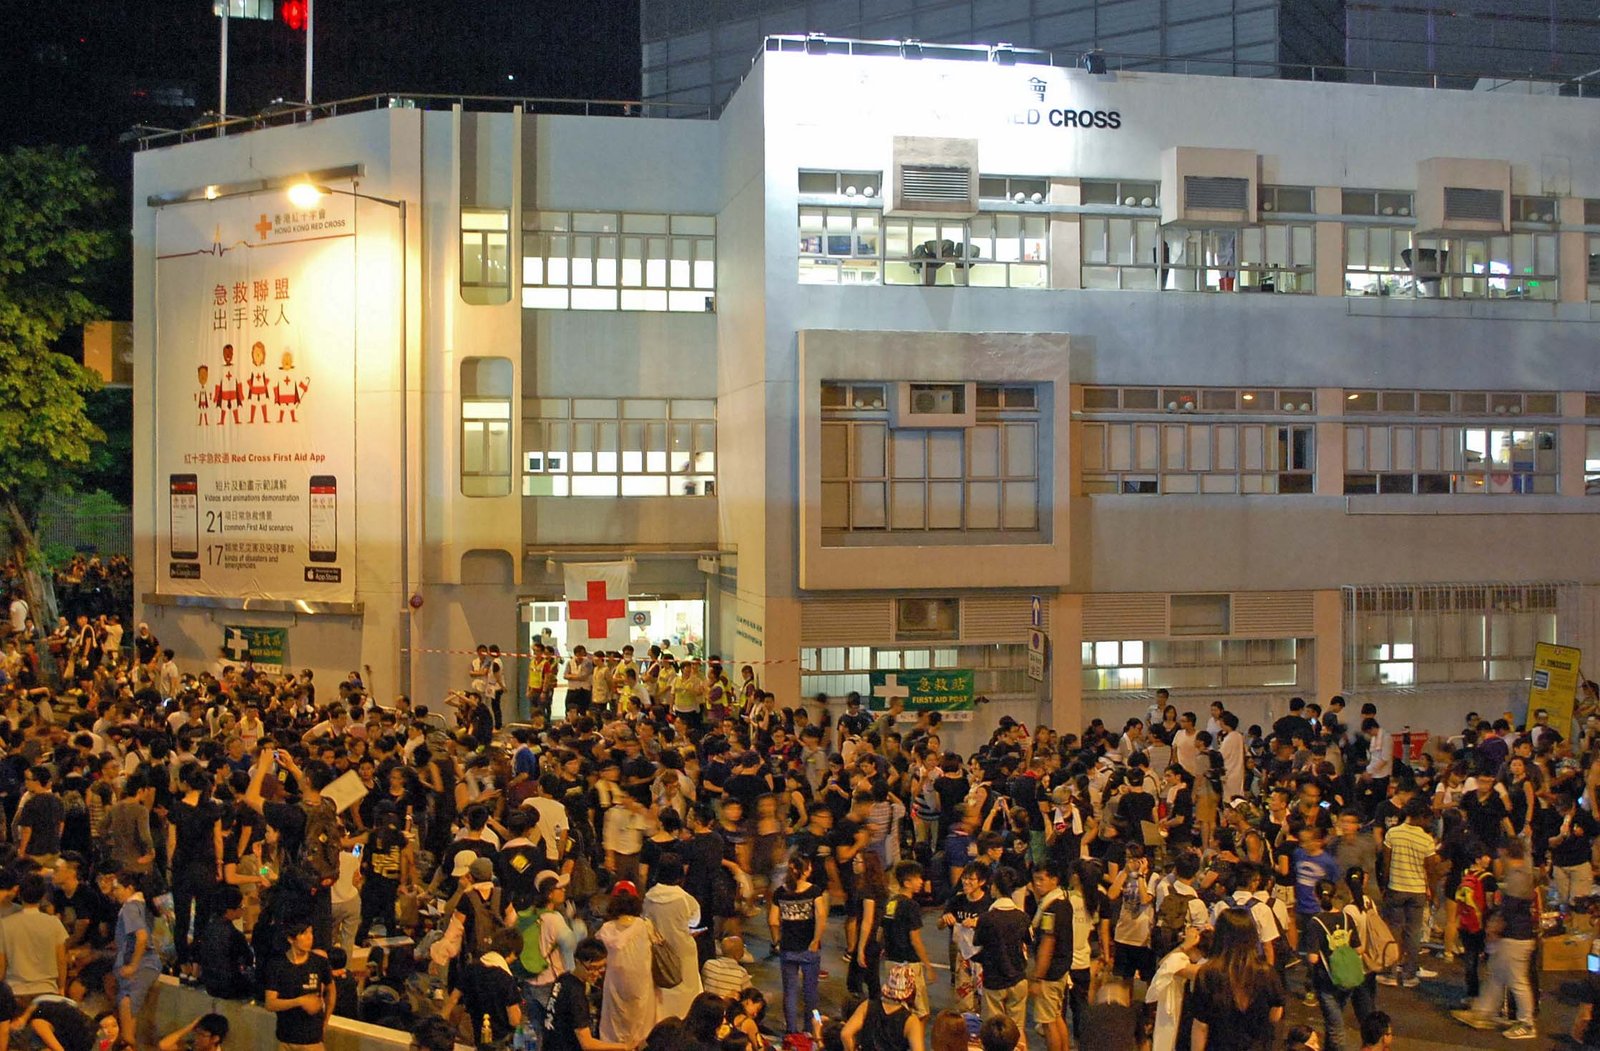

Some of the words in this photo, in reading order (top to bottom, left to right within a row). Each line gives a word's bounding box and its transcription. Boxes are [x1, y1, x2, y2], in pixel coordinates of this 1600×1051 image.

[1048, 108, 1121, 129] CROSS
[274, 226, 291, 235] HONG
[293, 224, 309, 232] KONG
[311, 222, 323, 230] RED
[324, 219, 346, 229] CROSS
[213, 278, 290, 306] 急救聯盟
[213, 303, 290, 331] 出手救人
[231, 453, 246, 462] Red
[248, 453, 271, 462] Cross
[273, 453, 292, 462] First
[294, 452, 308, 462] Aid
[310, 452, 326, 463] App
[206, 510, 223, 533] 21
[207, 543, 224, 566] 17
[912, 696, 934, 704] FIRST
[934, 695, 946, 703] AID
[948, 695, 968, 703] POST
